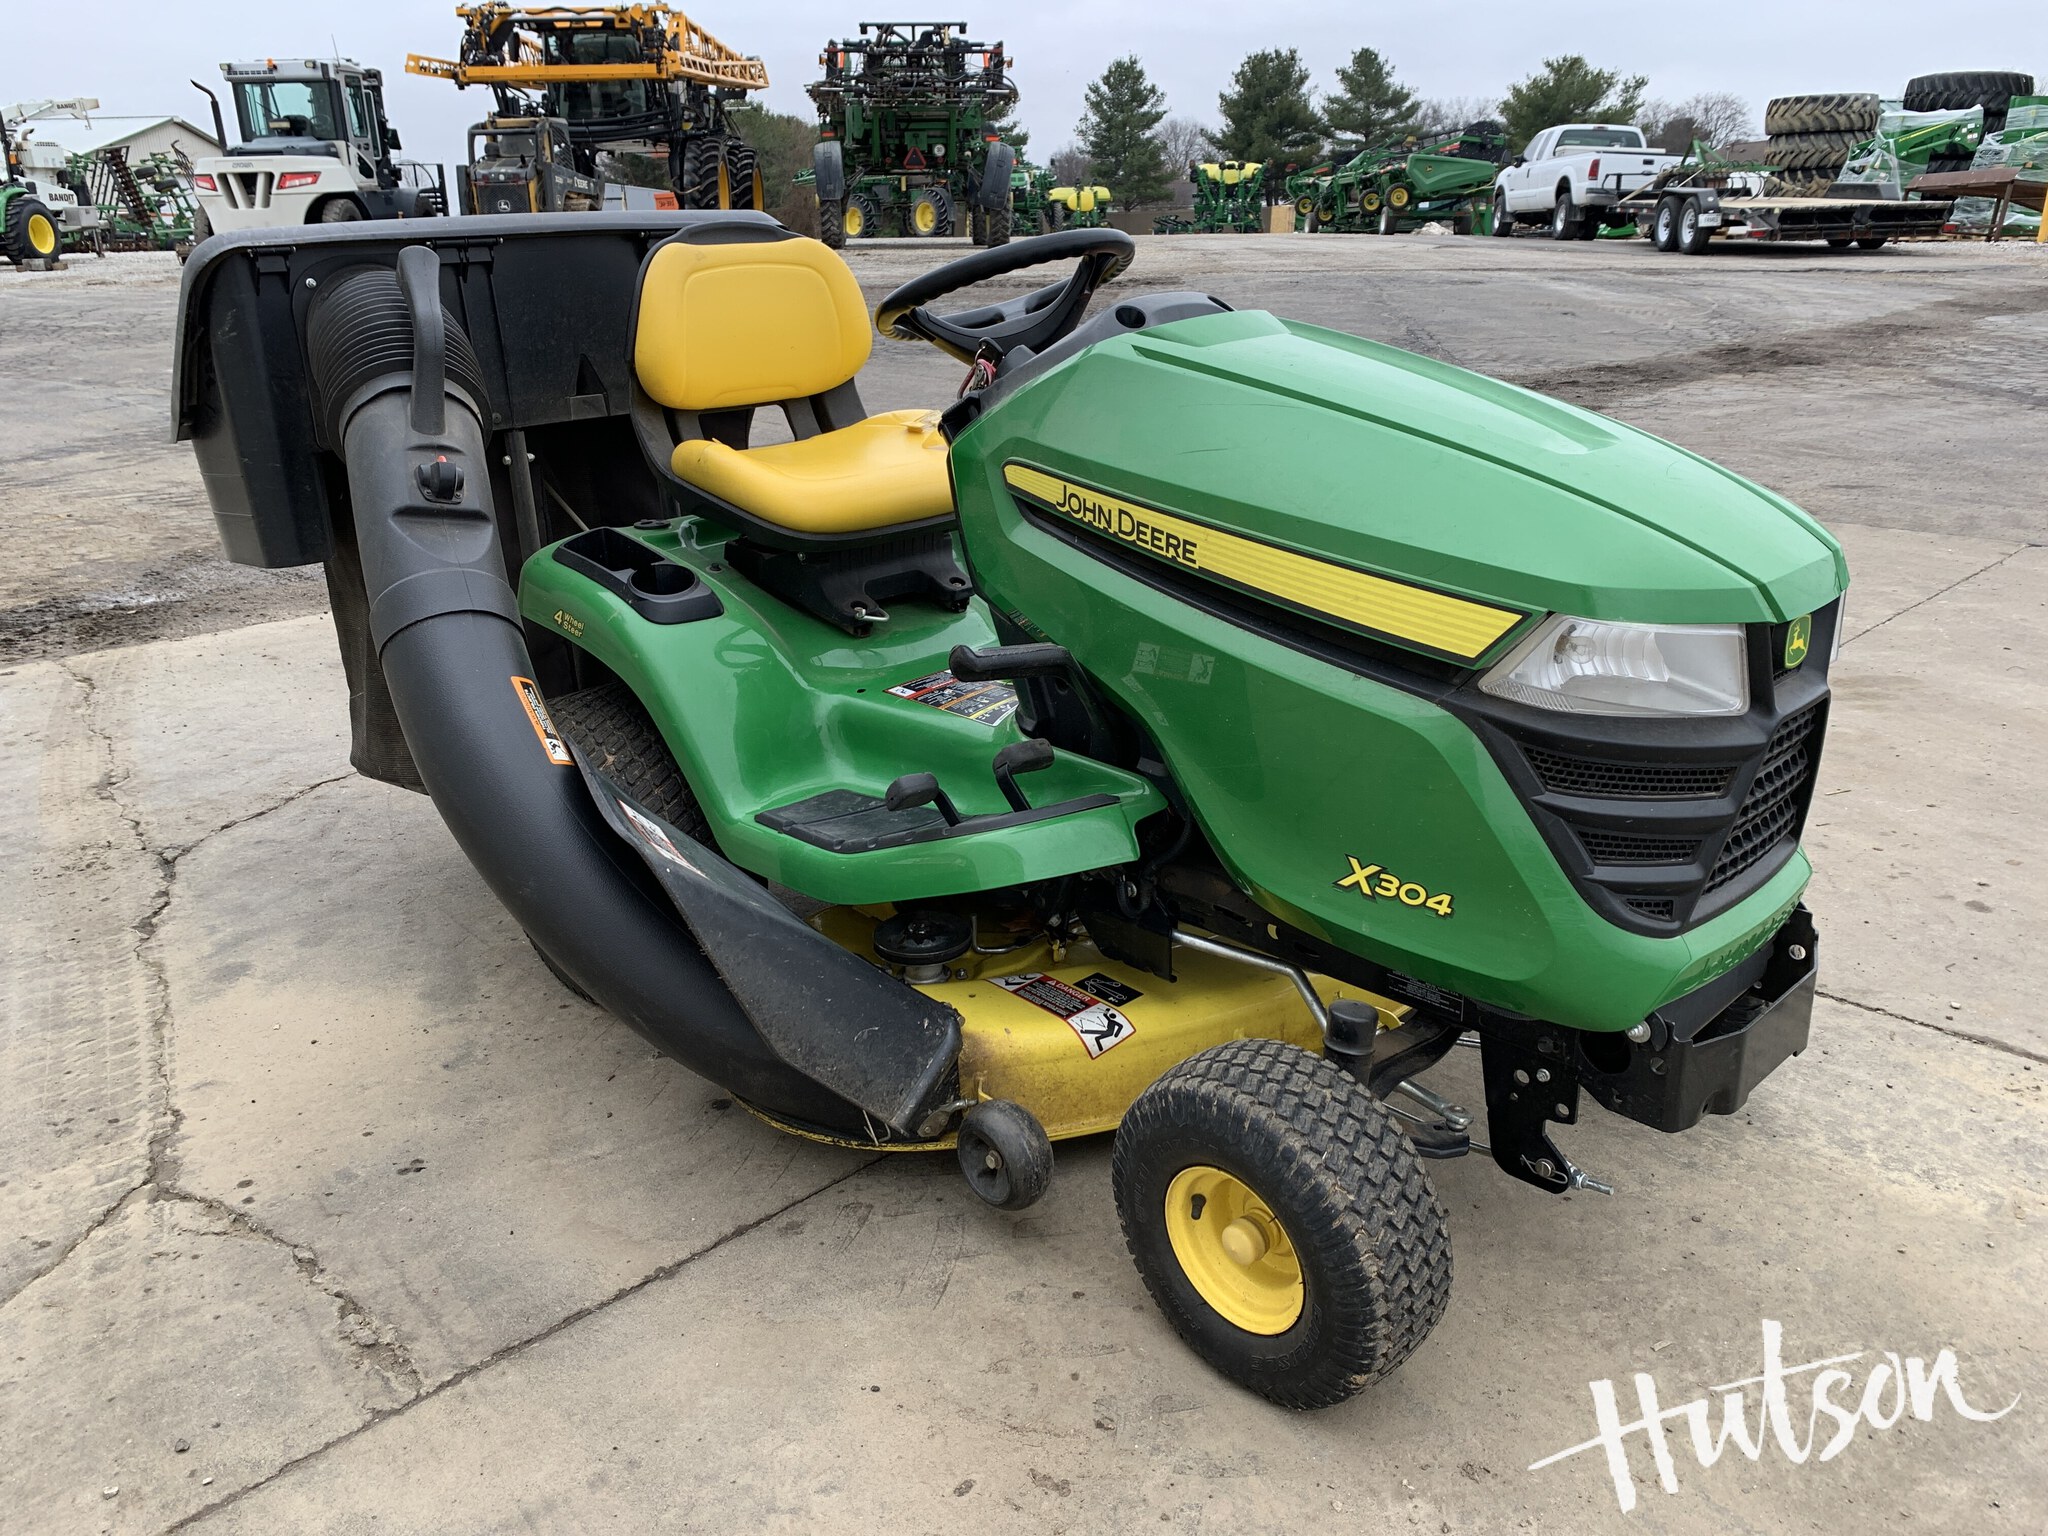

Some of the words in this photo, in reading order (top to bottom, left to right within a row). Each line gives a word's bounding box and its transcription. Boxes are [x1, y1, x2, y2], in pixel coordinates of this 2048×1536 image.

[56, 102, 78, 110] BANDIT
[48, 192, 75, 202] BANDIT
[1055, 484, 1114, 532] JOHN
[1117, 507, 1199, 568] DEERE
[553, 609, 564, 625] 4
[563, 612, 586, 631] Wheel
[562, 620, 583, 639] Steer
[1332, 853, 1455, 918] X304
[1055, 982, 1092, 1003] DANGER
